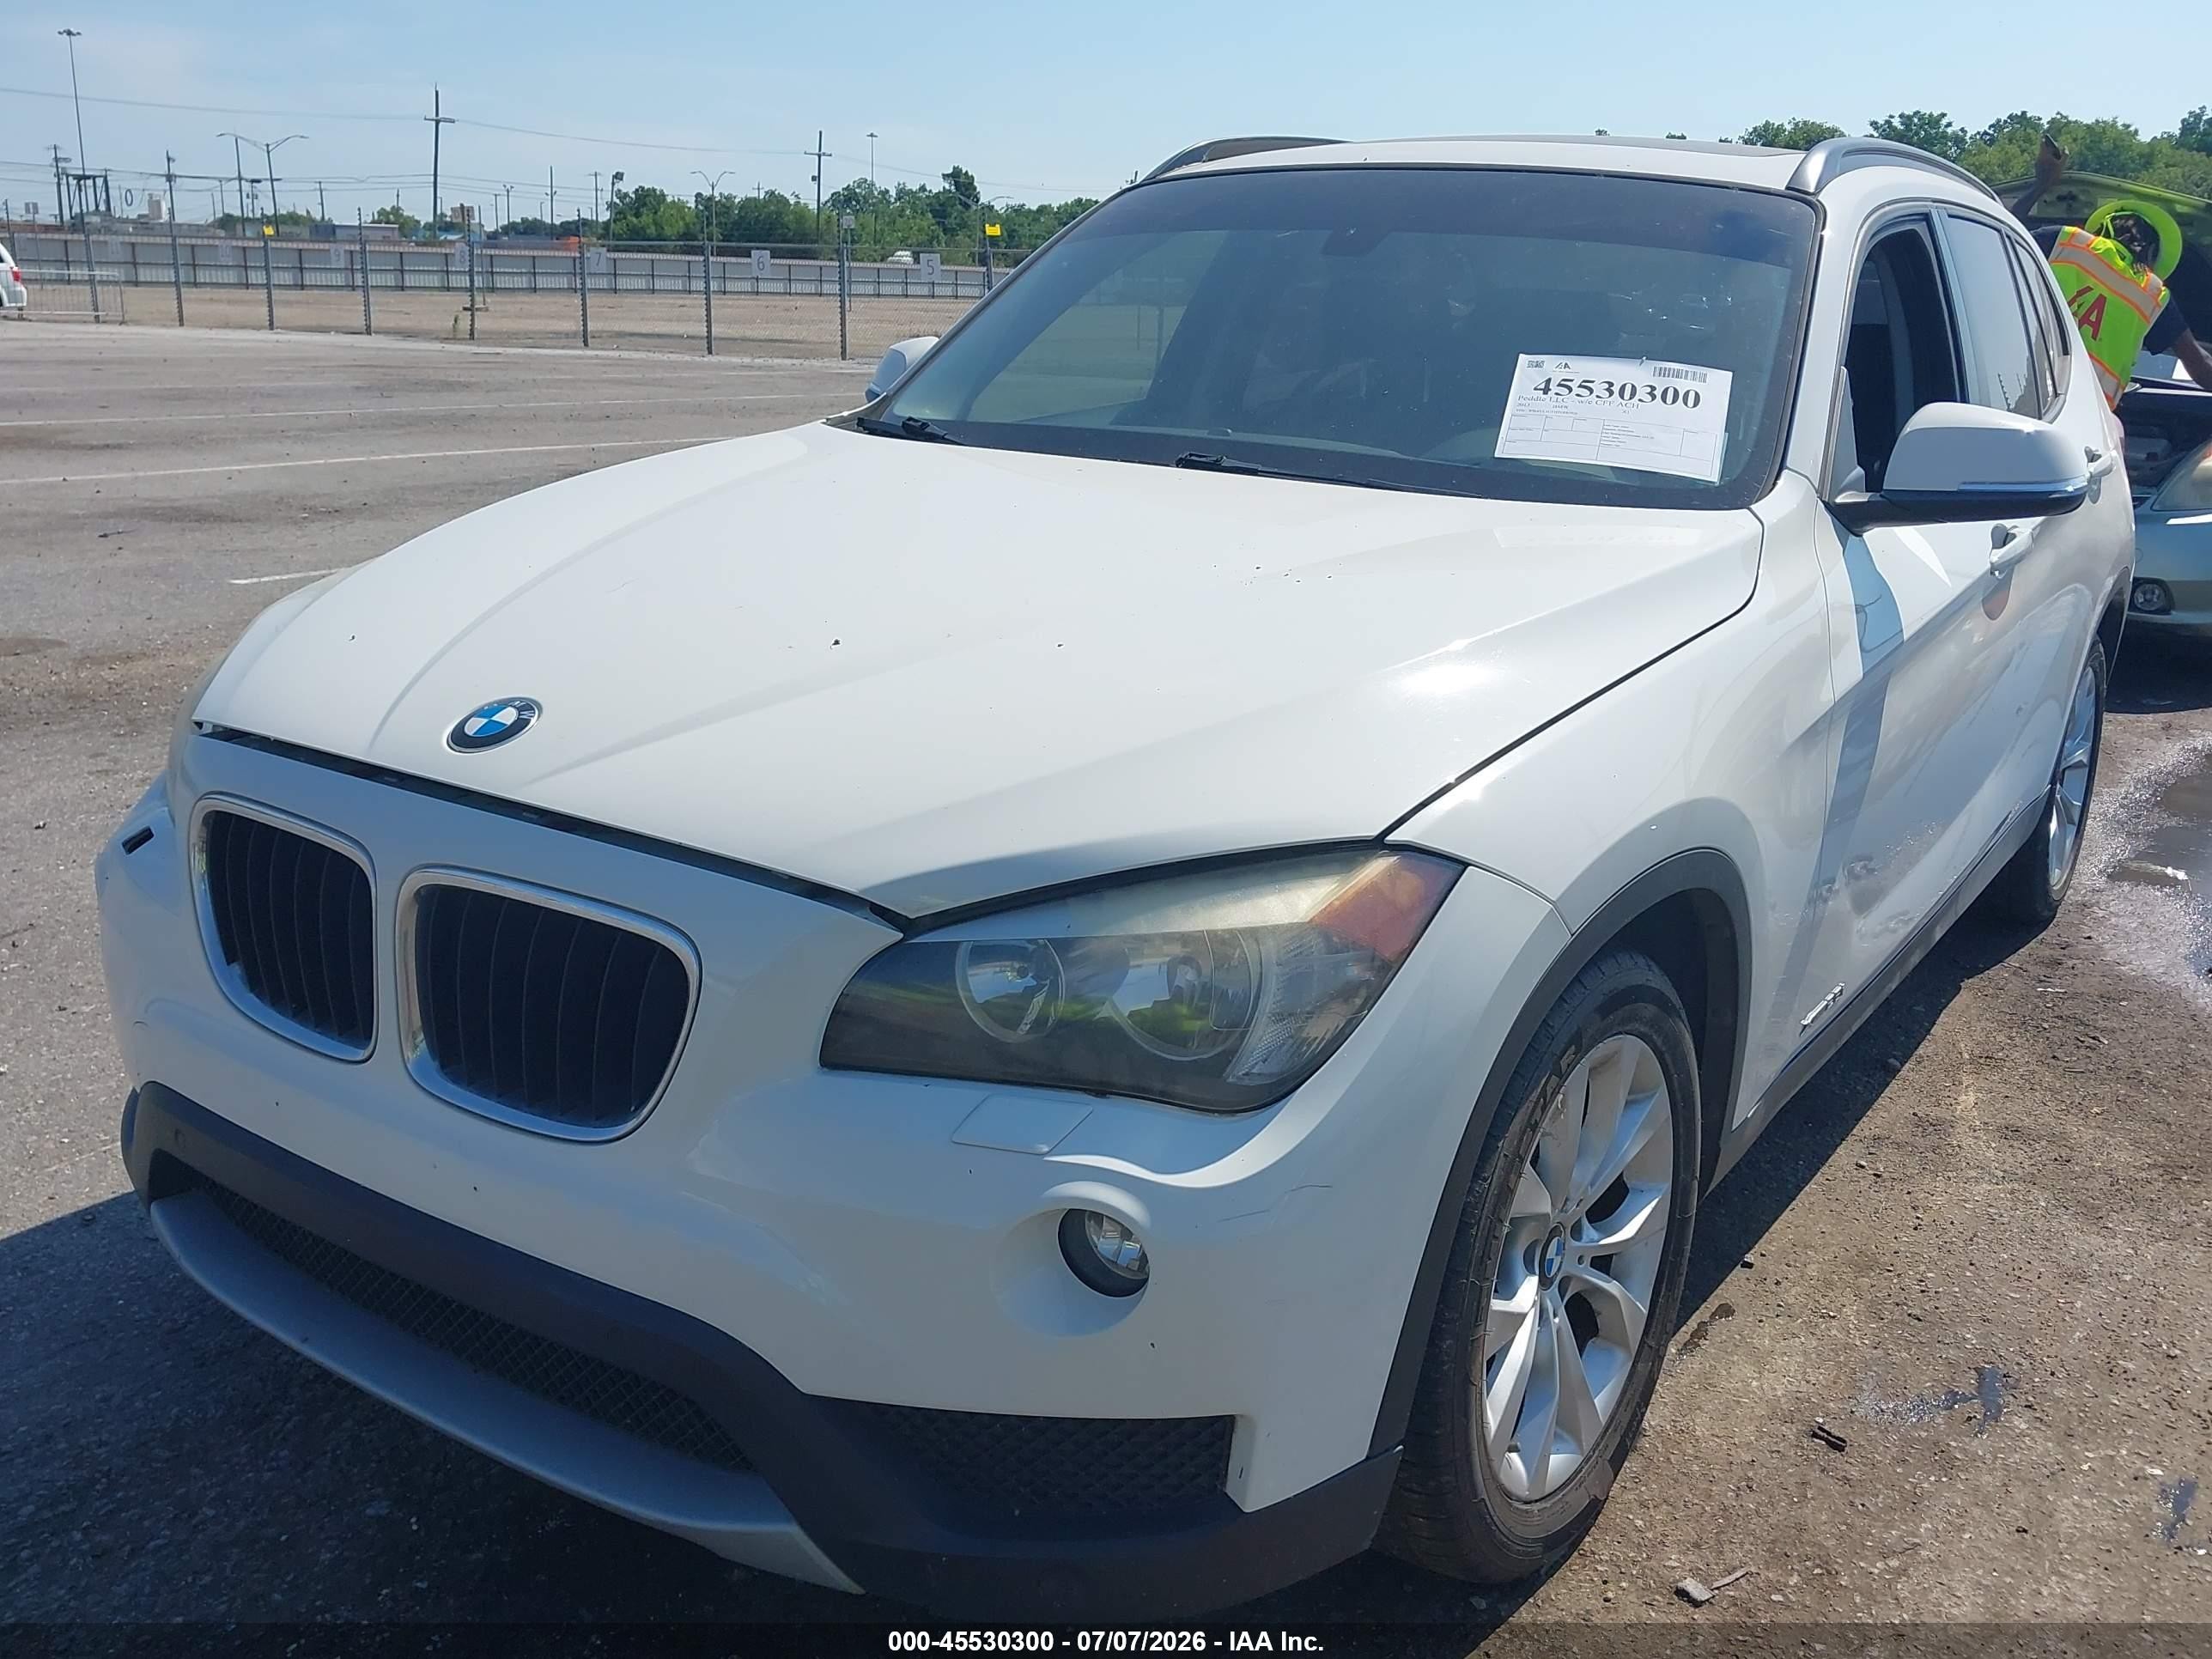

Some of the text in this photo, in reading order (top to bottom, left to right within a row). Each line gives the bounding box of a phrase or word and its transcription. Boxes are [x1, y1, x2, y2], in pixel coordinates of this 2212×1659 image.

[333, 247, 341, 263] 9
[459, 250, 466, 264] 8
[595, 252, 602, 266] 7
[757, 256, 765, 271] 6
[927, 259, 935, 276] 5
[1533, 376, 1701, 410] 45530300
